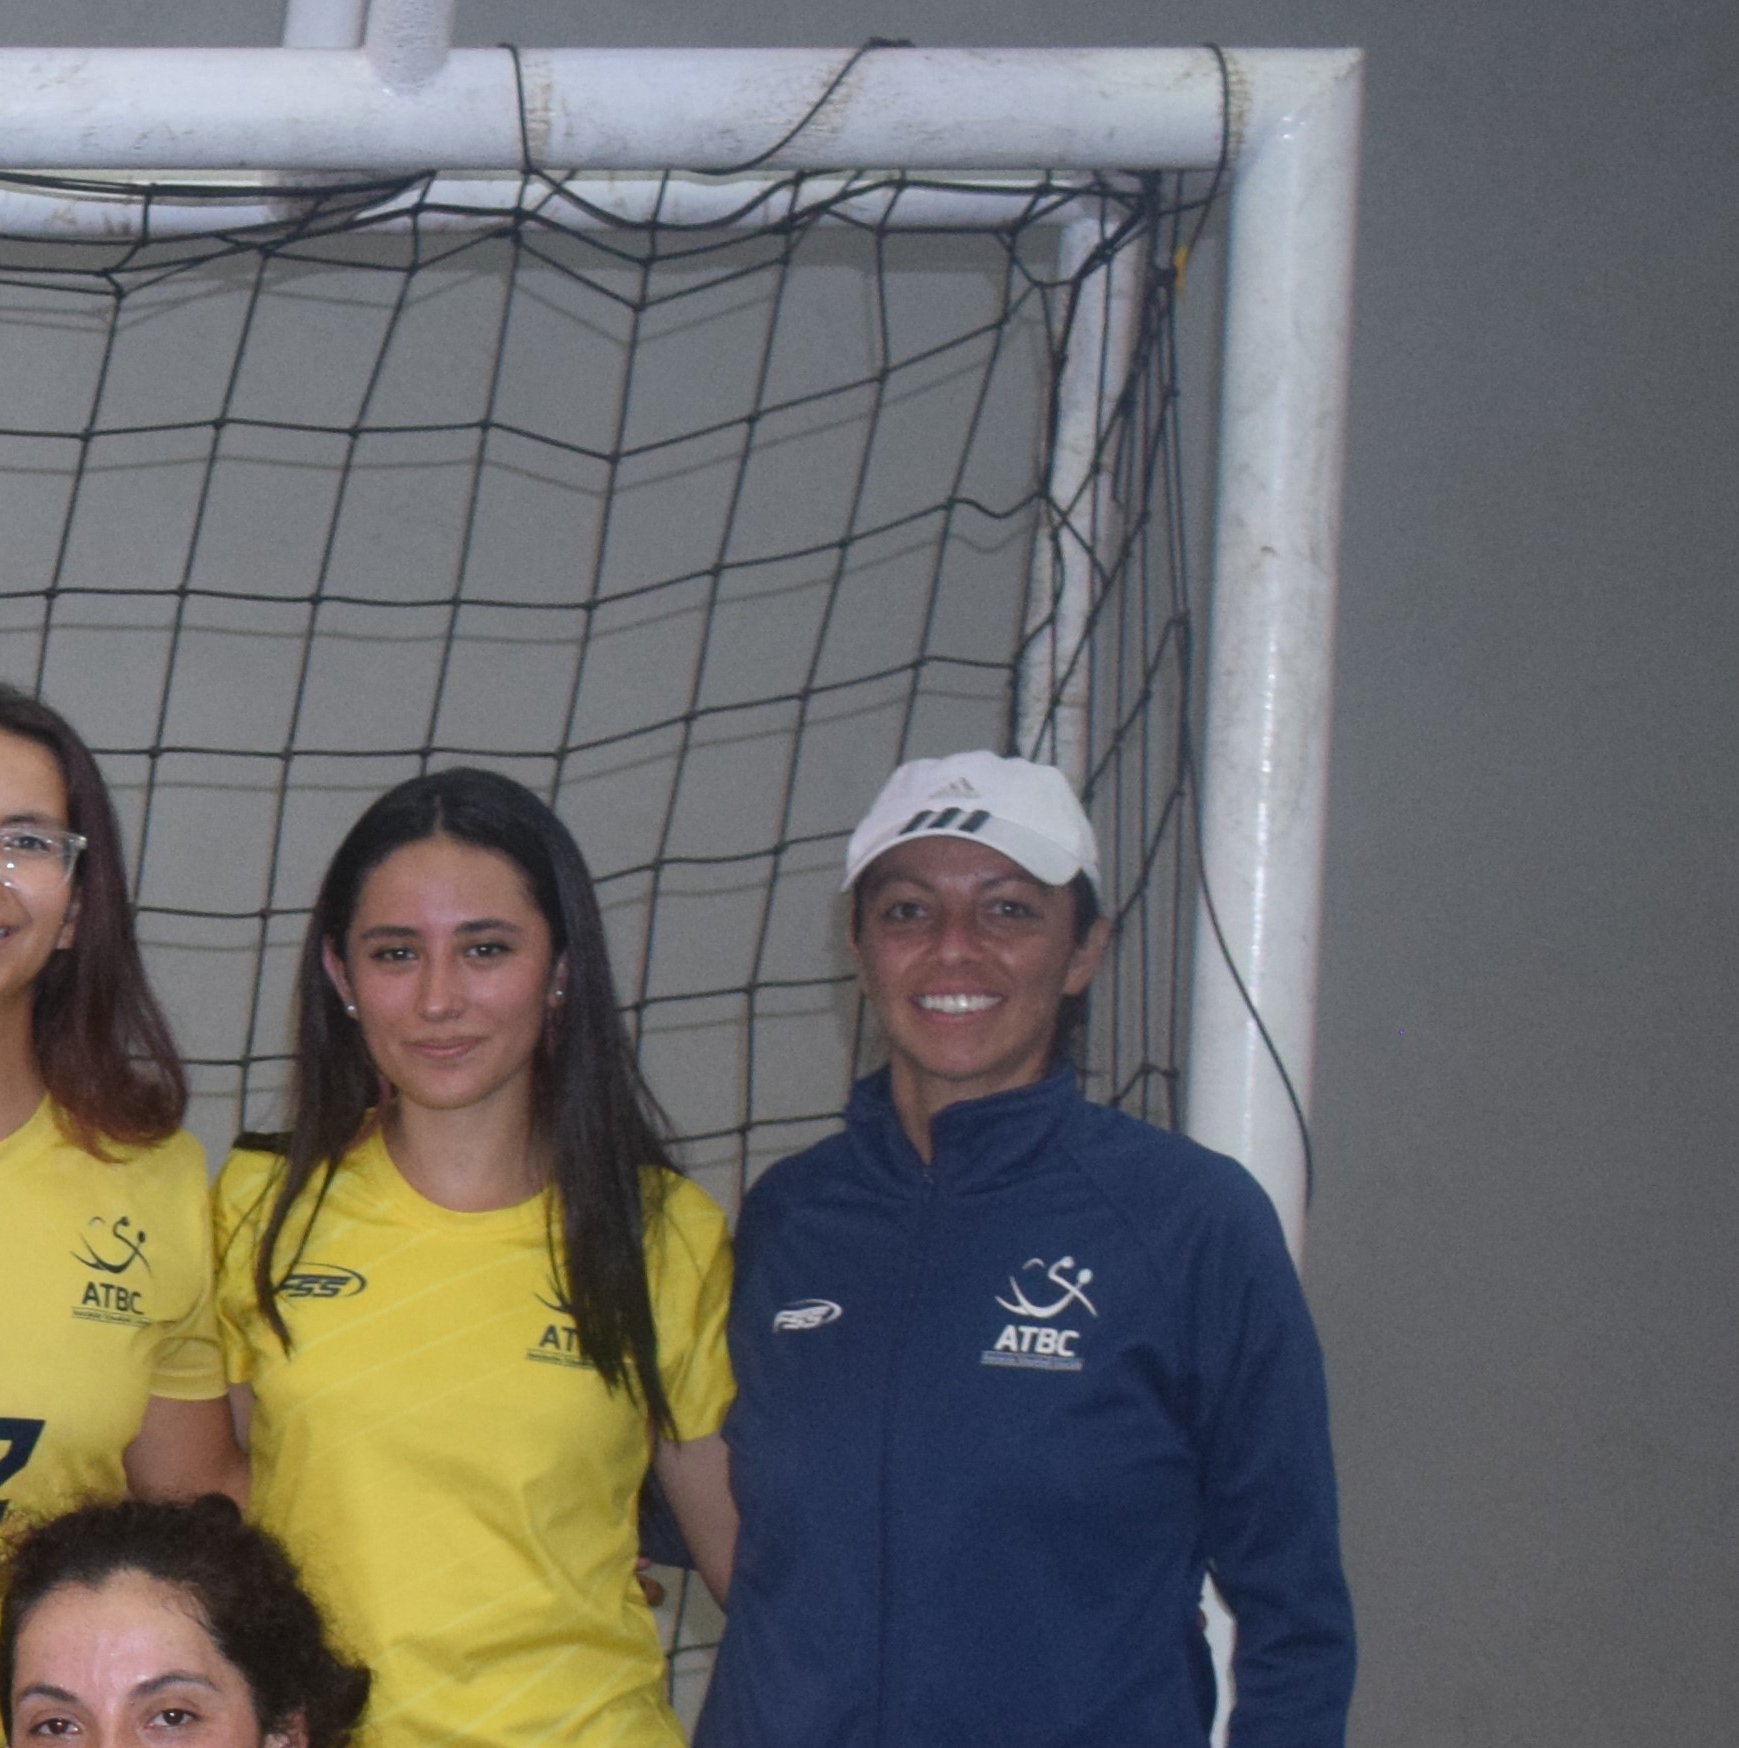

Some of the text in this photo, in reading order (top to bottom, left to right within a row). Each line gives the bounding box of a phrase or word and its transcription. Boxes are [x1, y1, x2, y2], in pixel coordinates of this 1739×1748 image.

[82, 1281, 144, 1315] ATBC
[539, 1324, 579, 1352] AT
[994, 1324, 1080, 1357] ATBC
